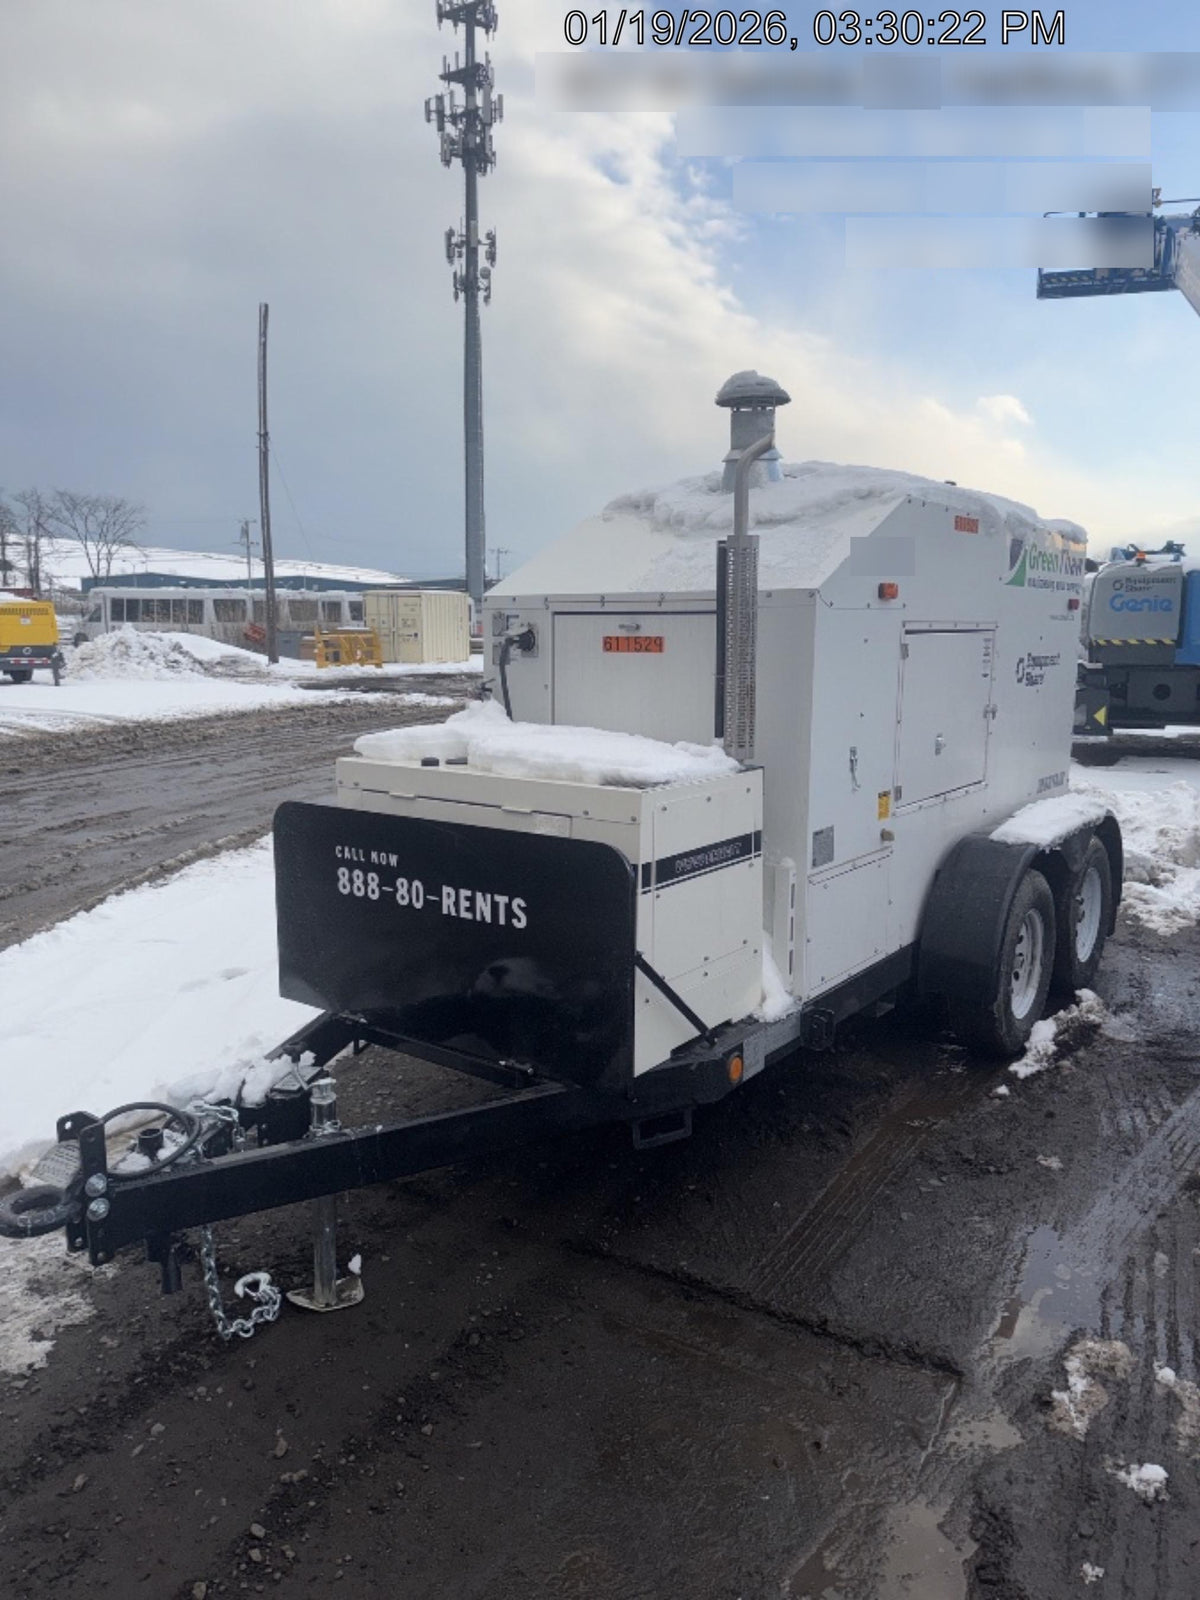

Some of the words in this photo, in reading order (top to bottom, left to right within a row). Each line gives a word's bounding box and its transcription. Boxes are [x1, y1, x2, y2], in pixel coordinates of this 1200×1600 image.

[1110, 593, 1173, 612] Genie
[603, 636, 663, 652] 611529
[335, 845, 365, 862] CALL
[371, 850, 399, 867] NOW
[337, 866, 527, 929] 888-80-RENTS
